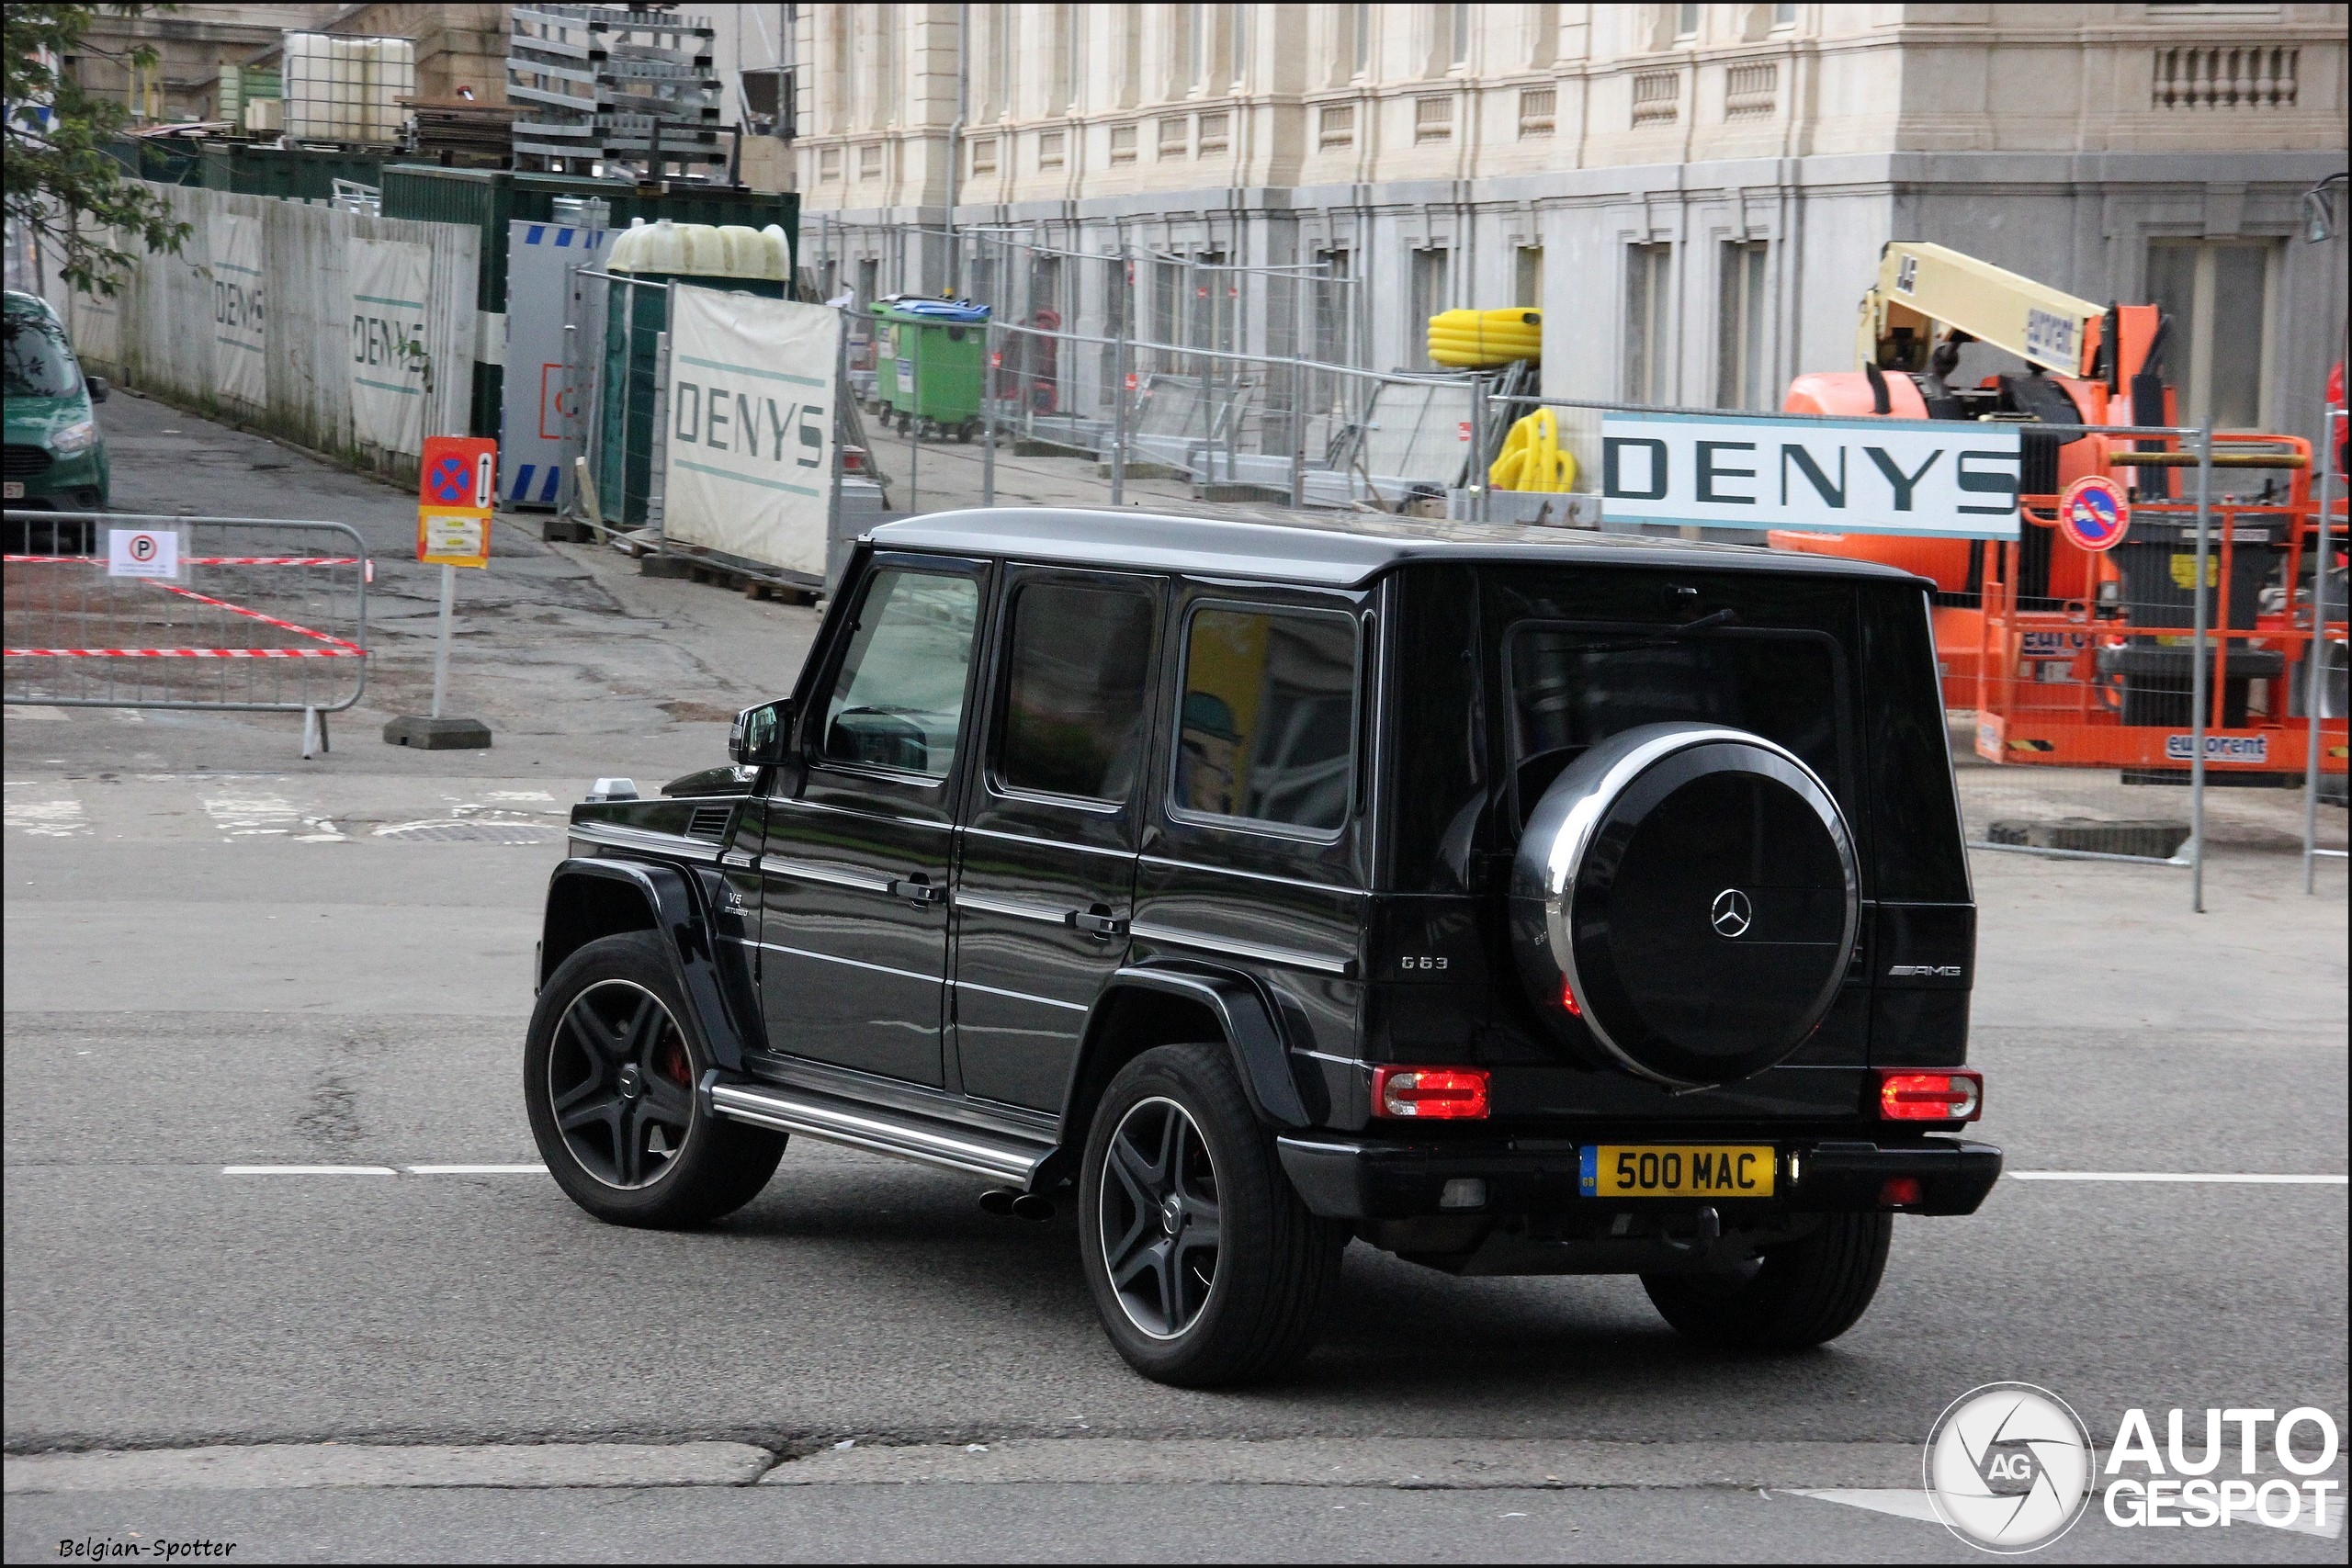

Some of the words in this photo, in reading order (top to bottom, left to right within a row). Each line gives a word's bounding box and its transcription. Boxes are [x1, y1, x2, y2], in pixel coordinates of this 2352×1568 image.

[675, 380, 824, 468] DENYS
[1603, 436, 2020, 514] DENYS
[138, 540, 150, 557] P
[729, 892, 742, 905] V8
[1910, 965, 1962, 976] AMG
[1616, 1152, 1682, 1190] 500
[1692, 1152, 1757, 1190] MAC
[1582, 1177, 1596, 1188] GB
